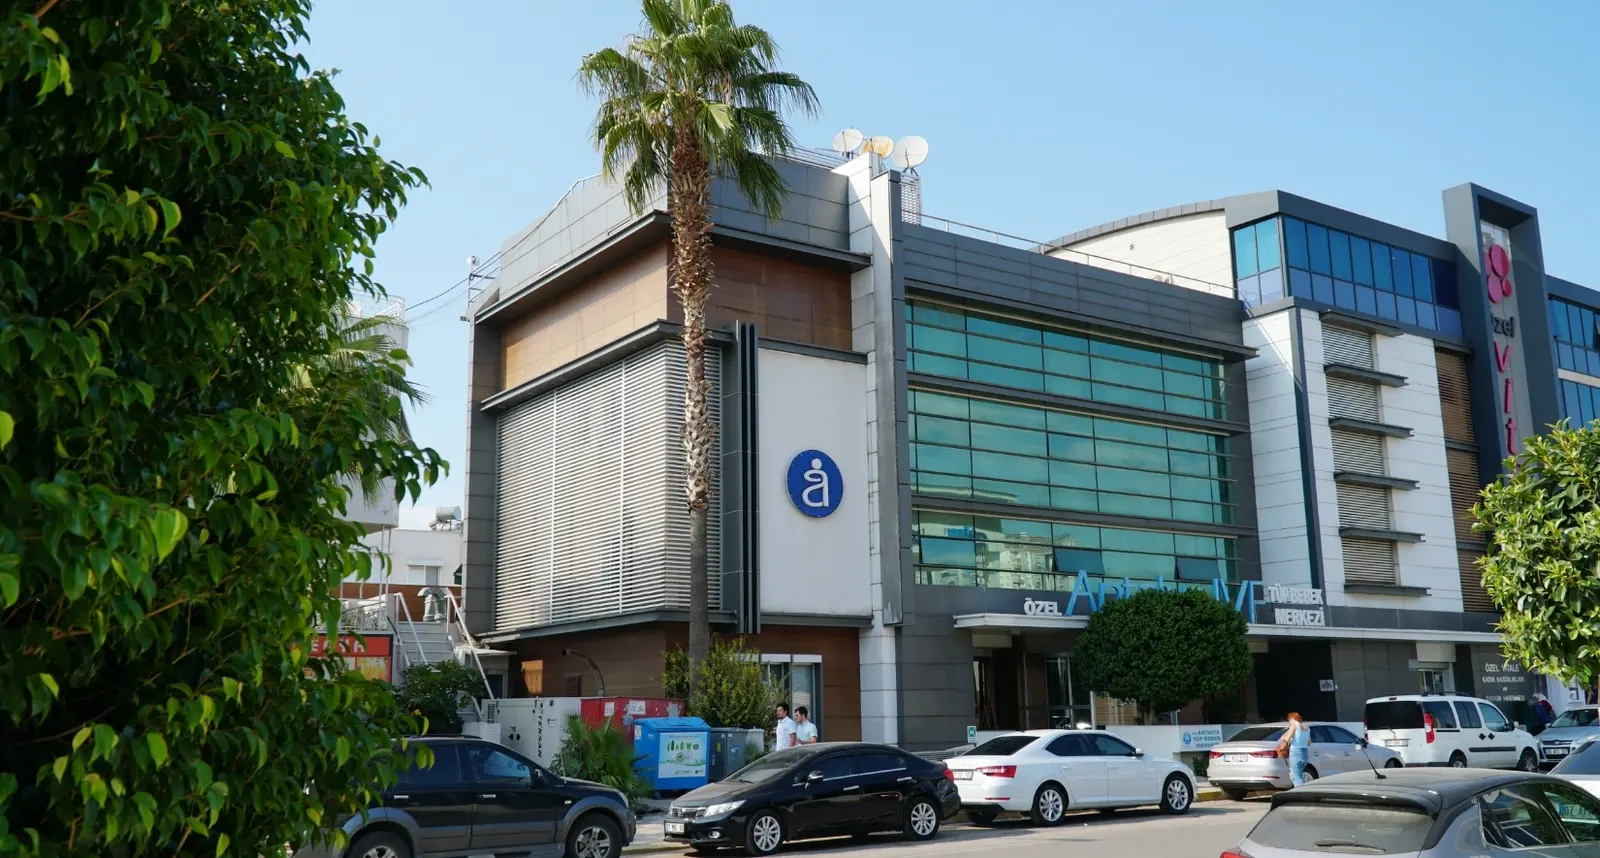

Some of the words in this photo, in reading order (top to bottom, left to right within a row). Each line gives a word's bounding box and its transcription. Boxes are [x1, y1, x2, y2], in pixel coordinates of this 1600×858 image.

[1490, 313, 1515, 338] zel
[1290, 587, 1324, 605] BEBEK
[1023, 597, 1063, 617] ÖZEL
[1274, 606, 1325, 626] MERKEZİ
